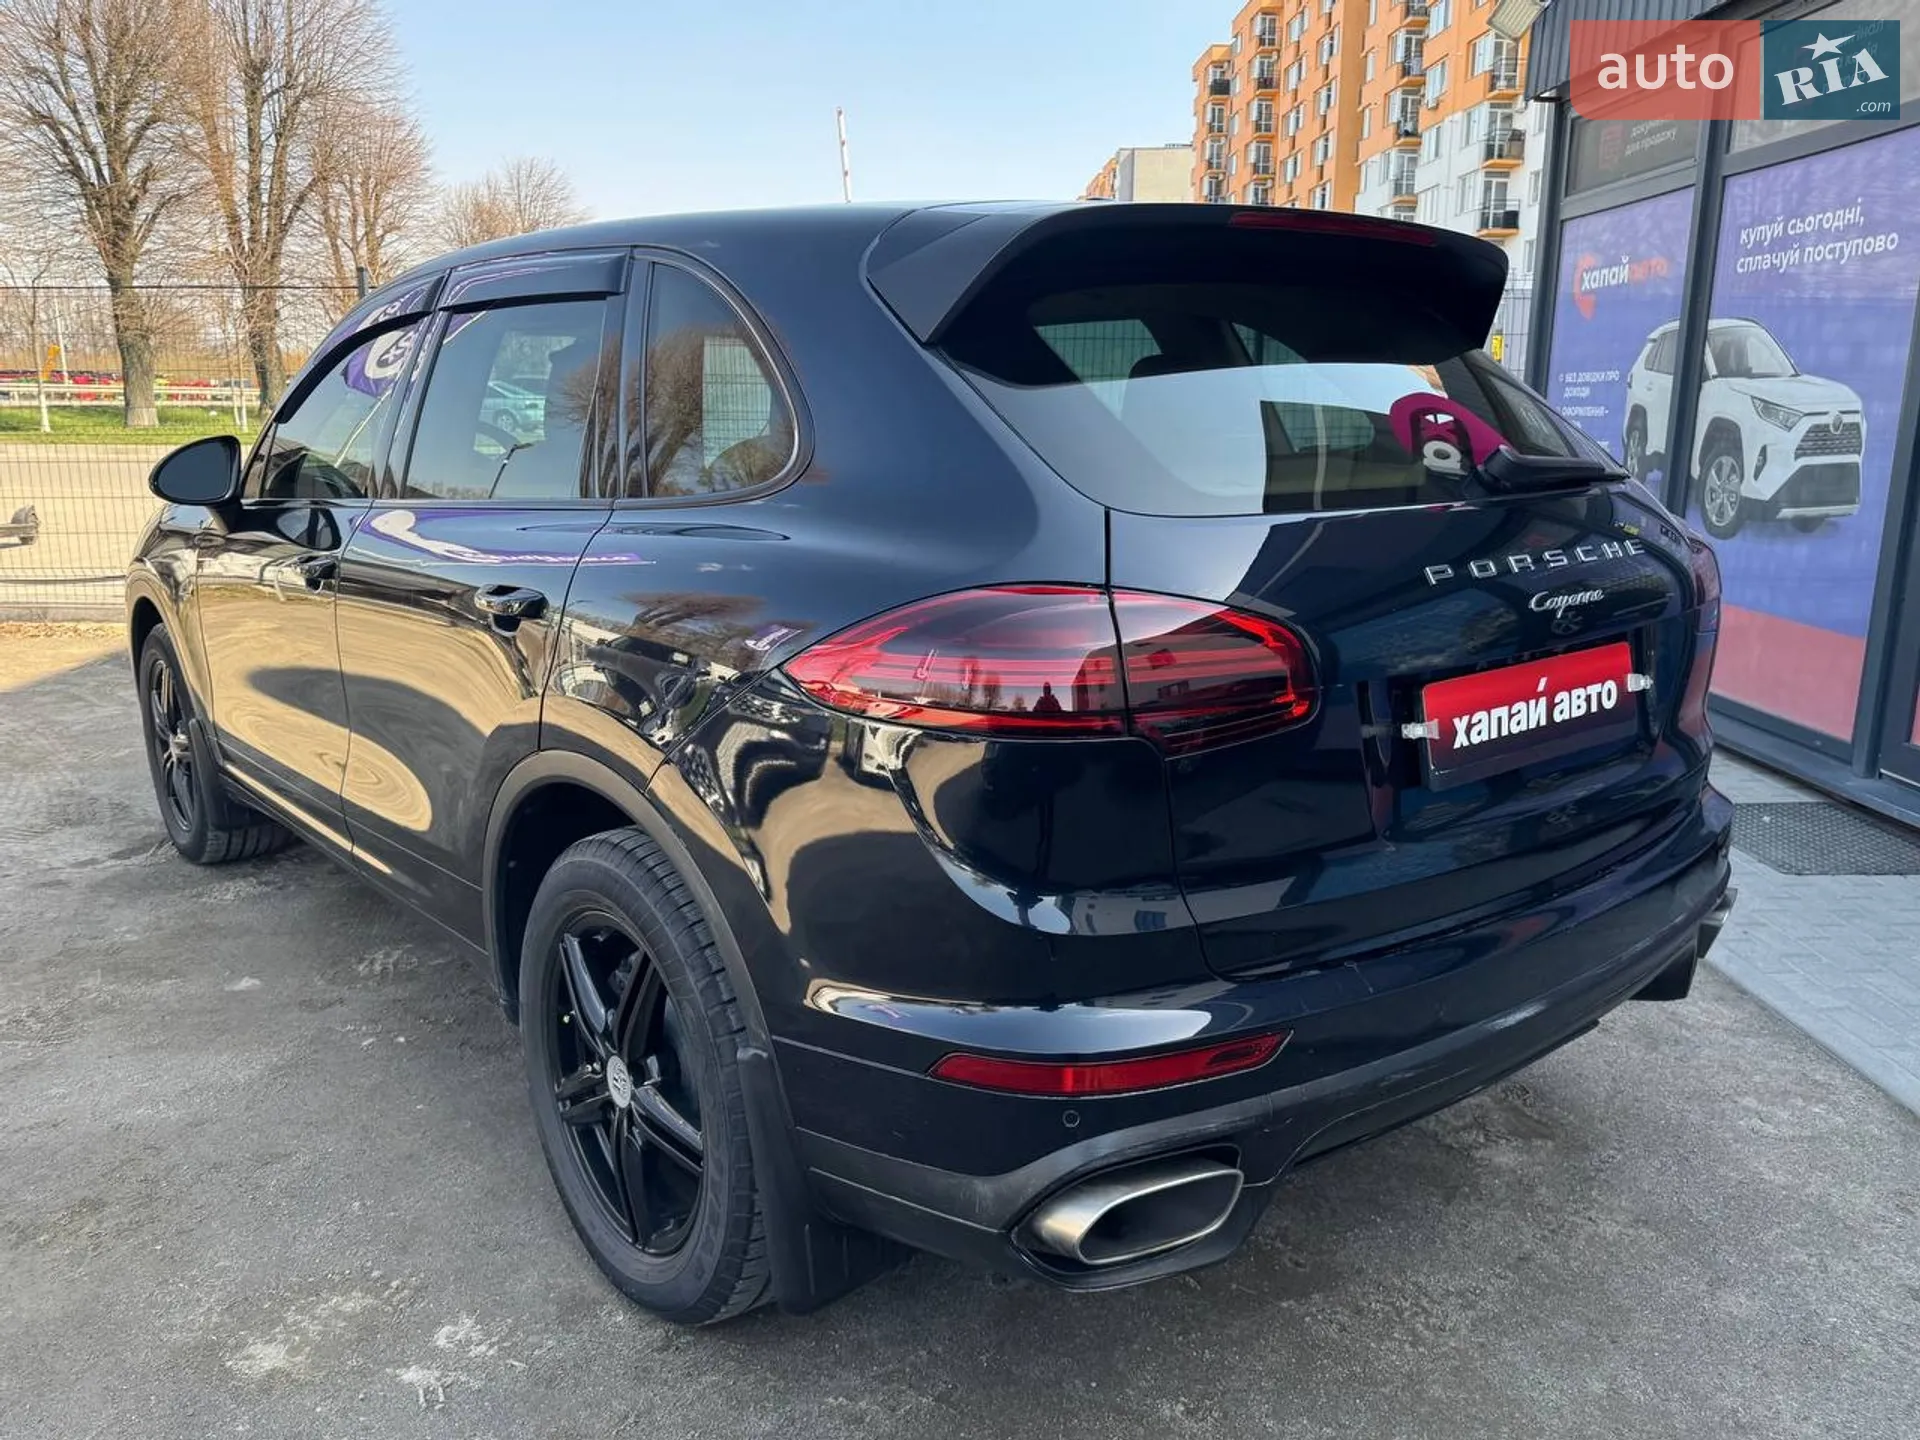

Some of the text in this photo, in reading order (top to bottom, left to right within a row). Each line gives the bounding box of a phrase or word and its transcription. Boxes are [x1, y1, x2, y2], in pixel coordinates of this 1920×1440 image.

[1740, 197, 1864, 248] купуй сьогодні,
[1736, 232, 1899, 273] сплачуй поступово
[1423, 538, 1646, 586] PORSCHE
[1528, 588, 1605, 618] Cayenne
[1552, 679, 1618, 723] авто
